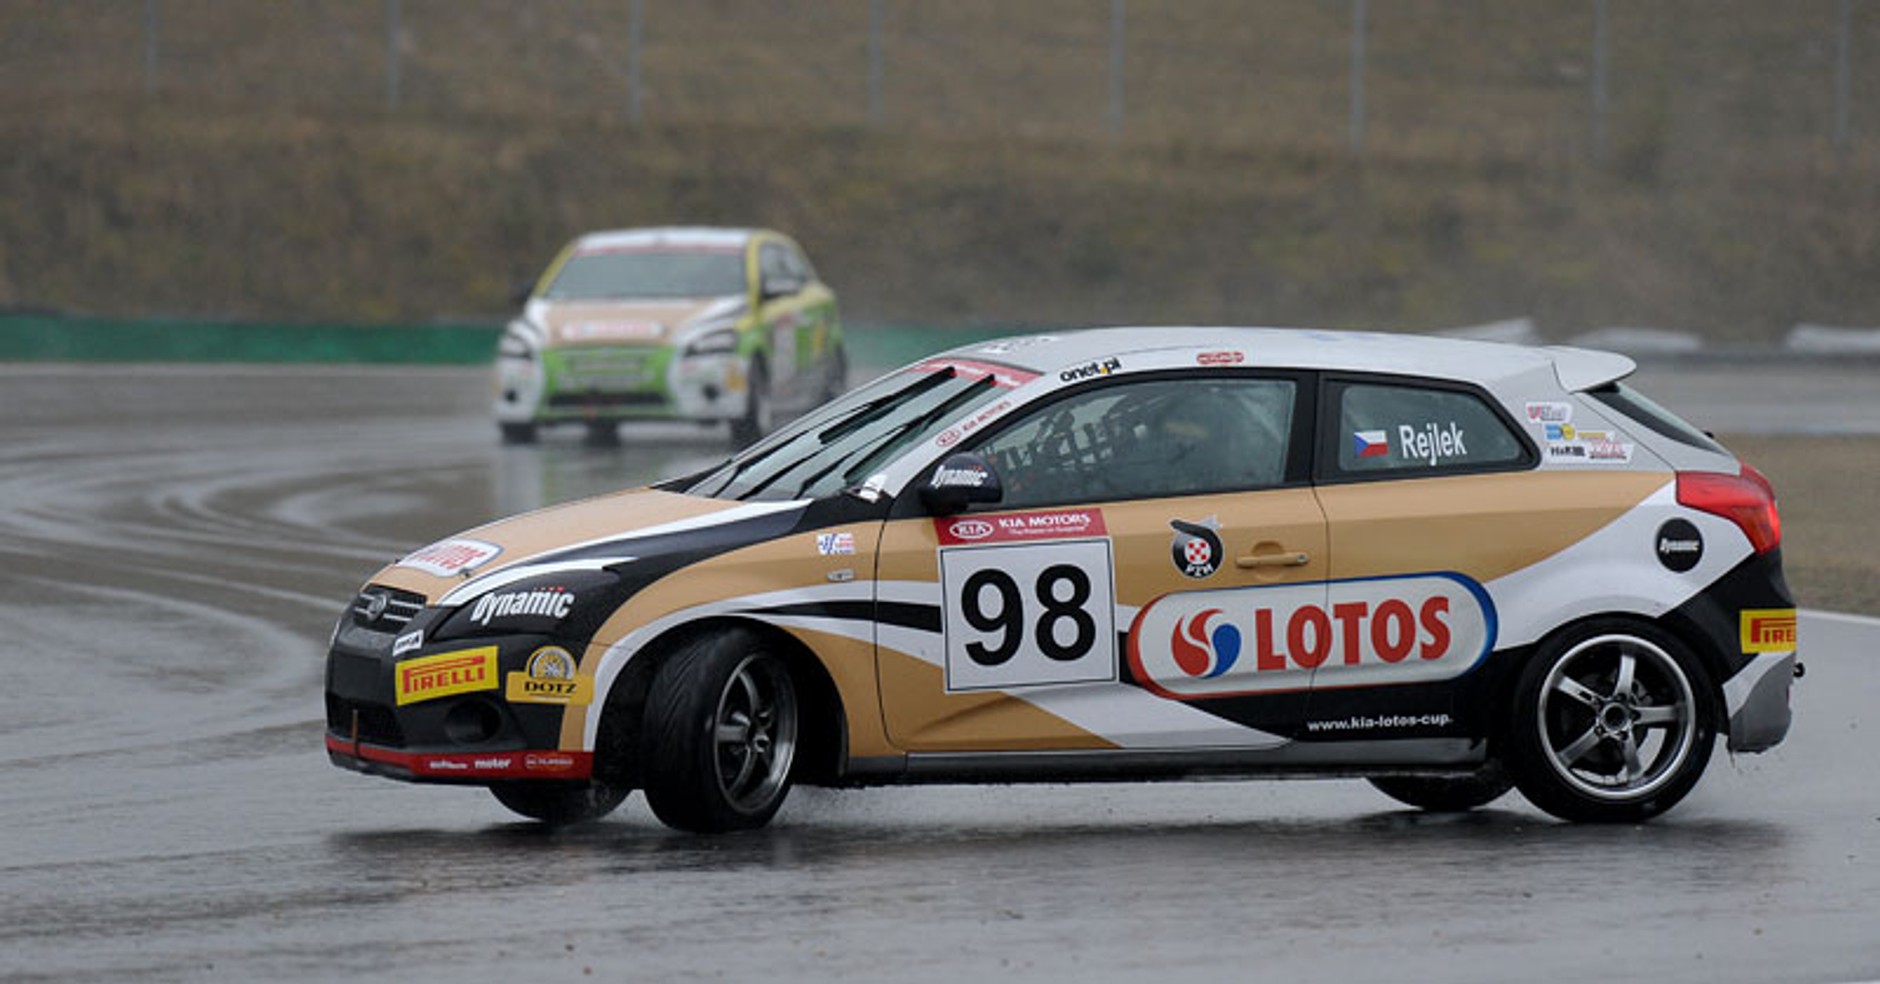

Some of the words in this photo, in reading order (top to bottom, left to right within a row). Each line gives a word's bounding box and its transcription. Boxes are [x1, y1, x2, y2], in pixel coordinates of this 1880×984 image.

[1060, 357, 1122, 382] onet.pl
[1399, 421, 1467, 466] Rejlek
[999, 517, 1025, 528] KIA
[1029, 514, 1091, 527] MOTORS
[961, 564, 1096, 667] 98
[1255, 596, 1452, 672] LOTOS
[403, 656, 485, 694] PIRELLI
[525, 681, 576, 694] DOTZ
